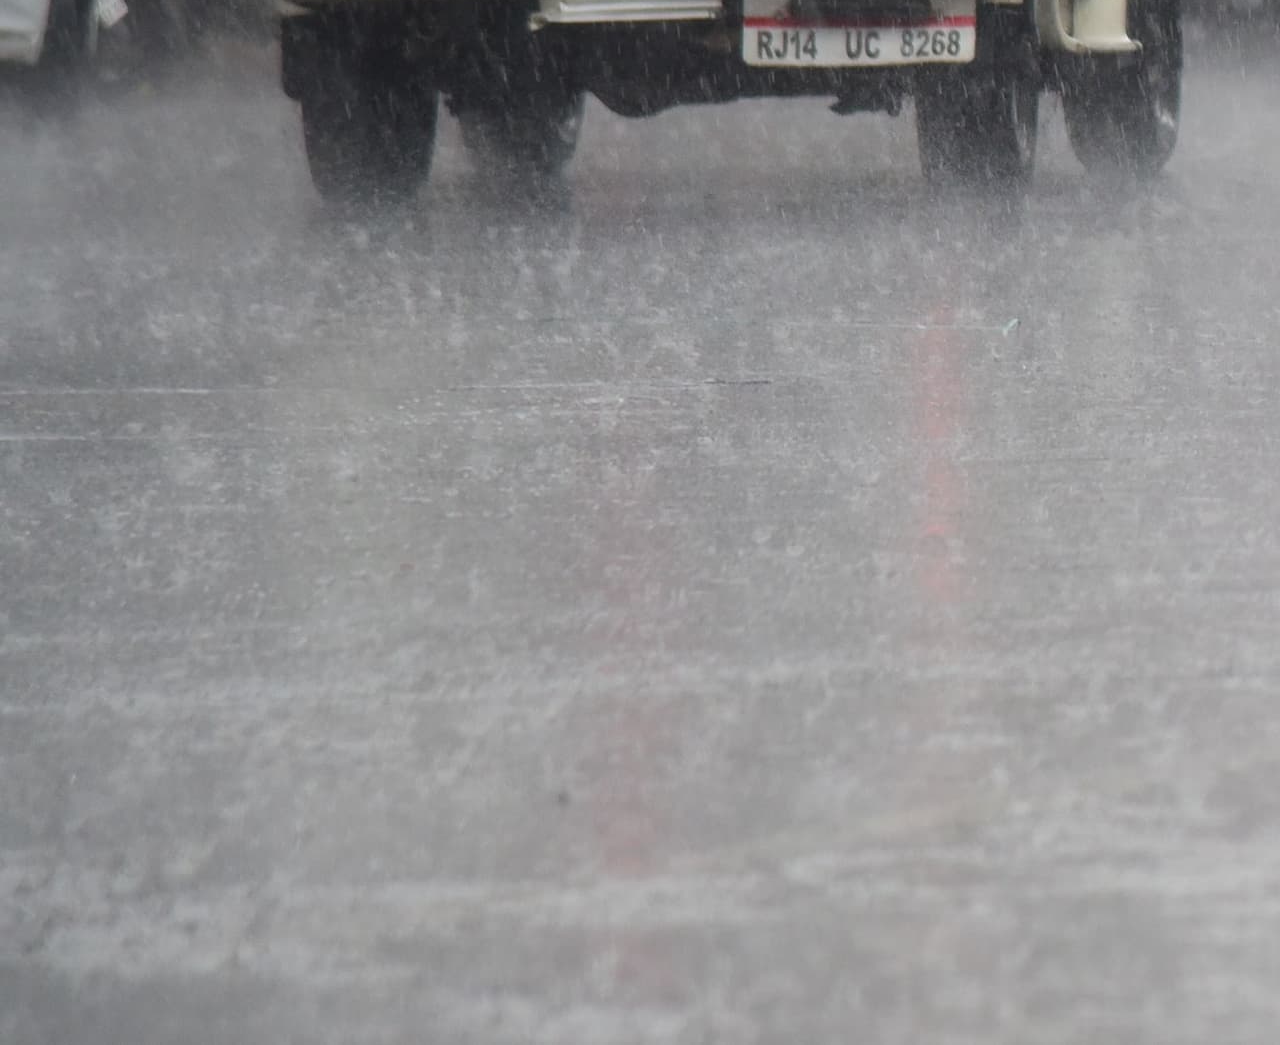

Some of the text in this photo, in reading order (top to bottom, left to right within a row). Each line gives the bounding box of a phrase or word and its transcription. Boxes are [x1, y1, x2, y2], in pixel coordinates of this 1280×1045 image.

[757, 29, 961, 60] RJ14 UC 8268
